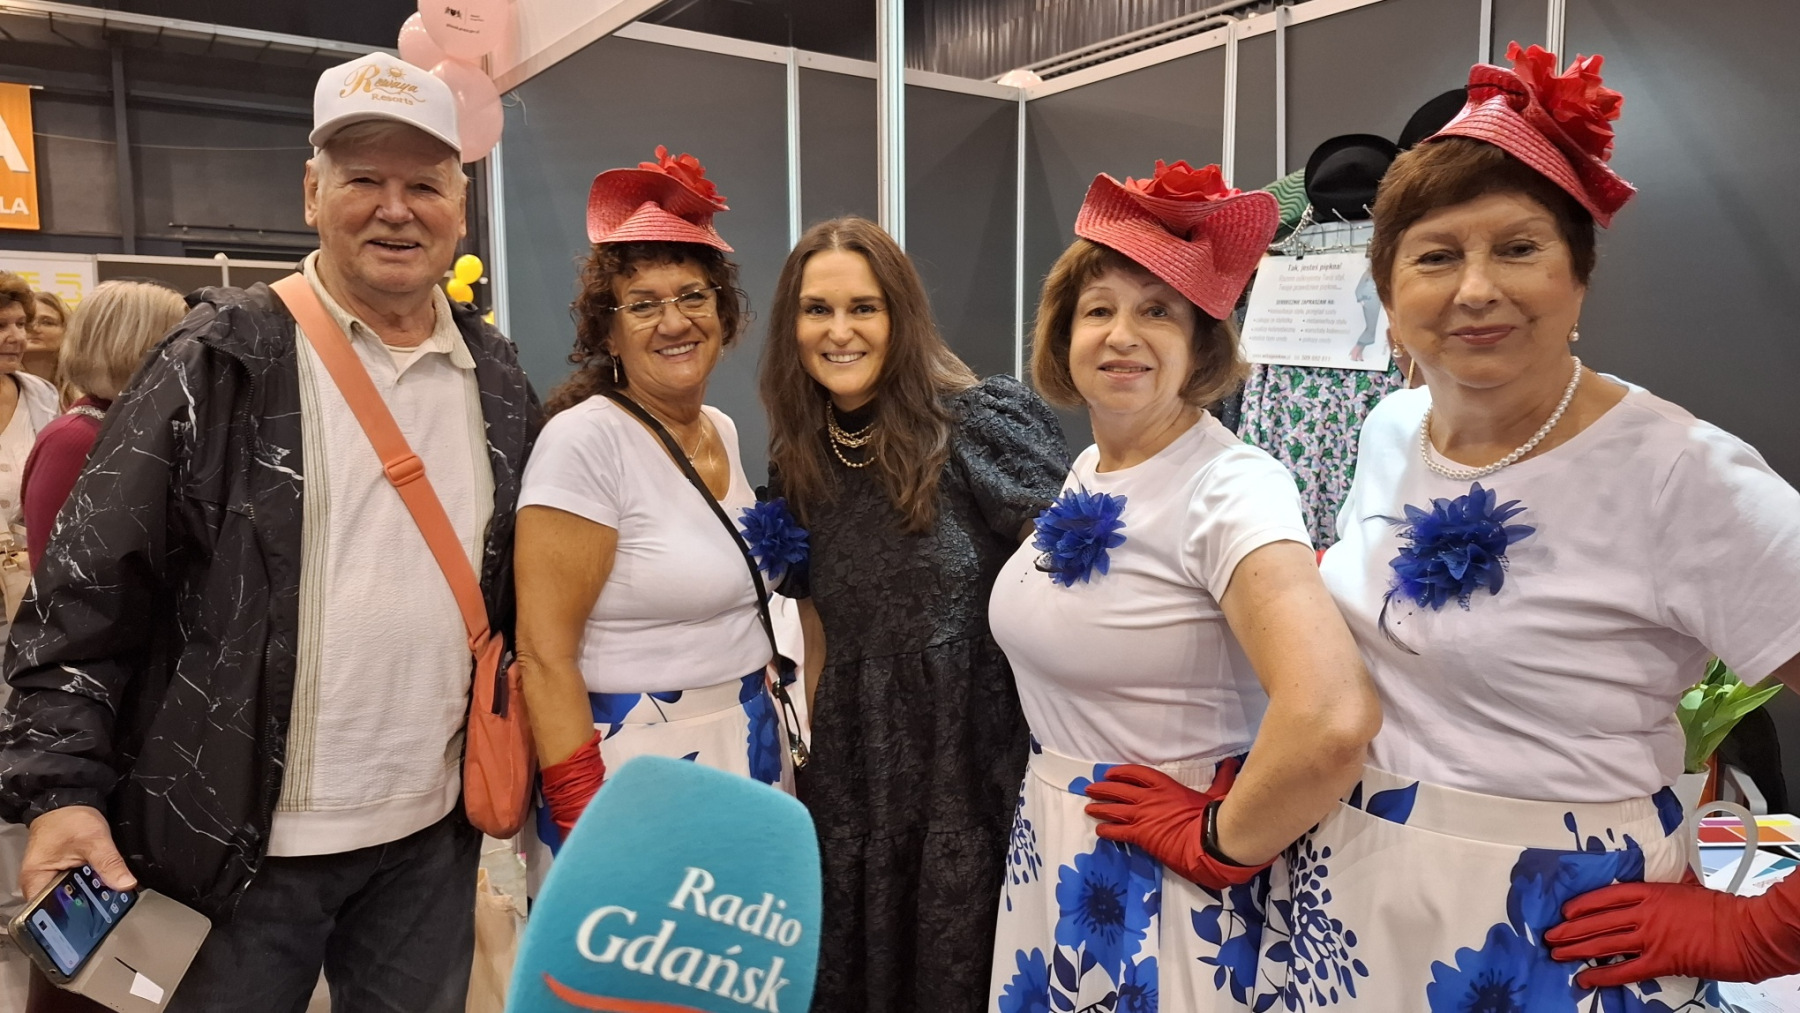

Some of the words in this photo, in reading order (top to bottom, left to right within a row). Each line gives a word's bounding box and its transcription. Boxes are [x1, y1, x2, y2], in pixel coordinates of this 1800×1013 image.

[339, 64, 418, 98] Rewaya
[372, 93, 413, 105] Resorts
[668, 866, 803, 948] Radio
[576, 904, 790, 1013] Gdańsk
